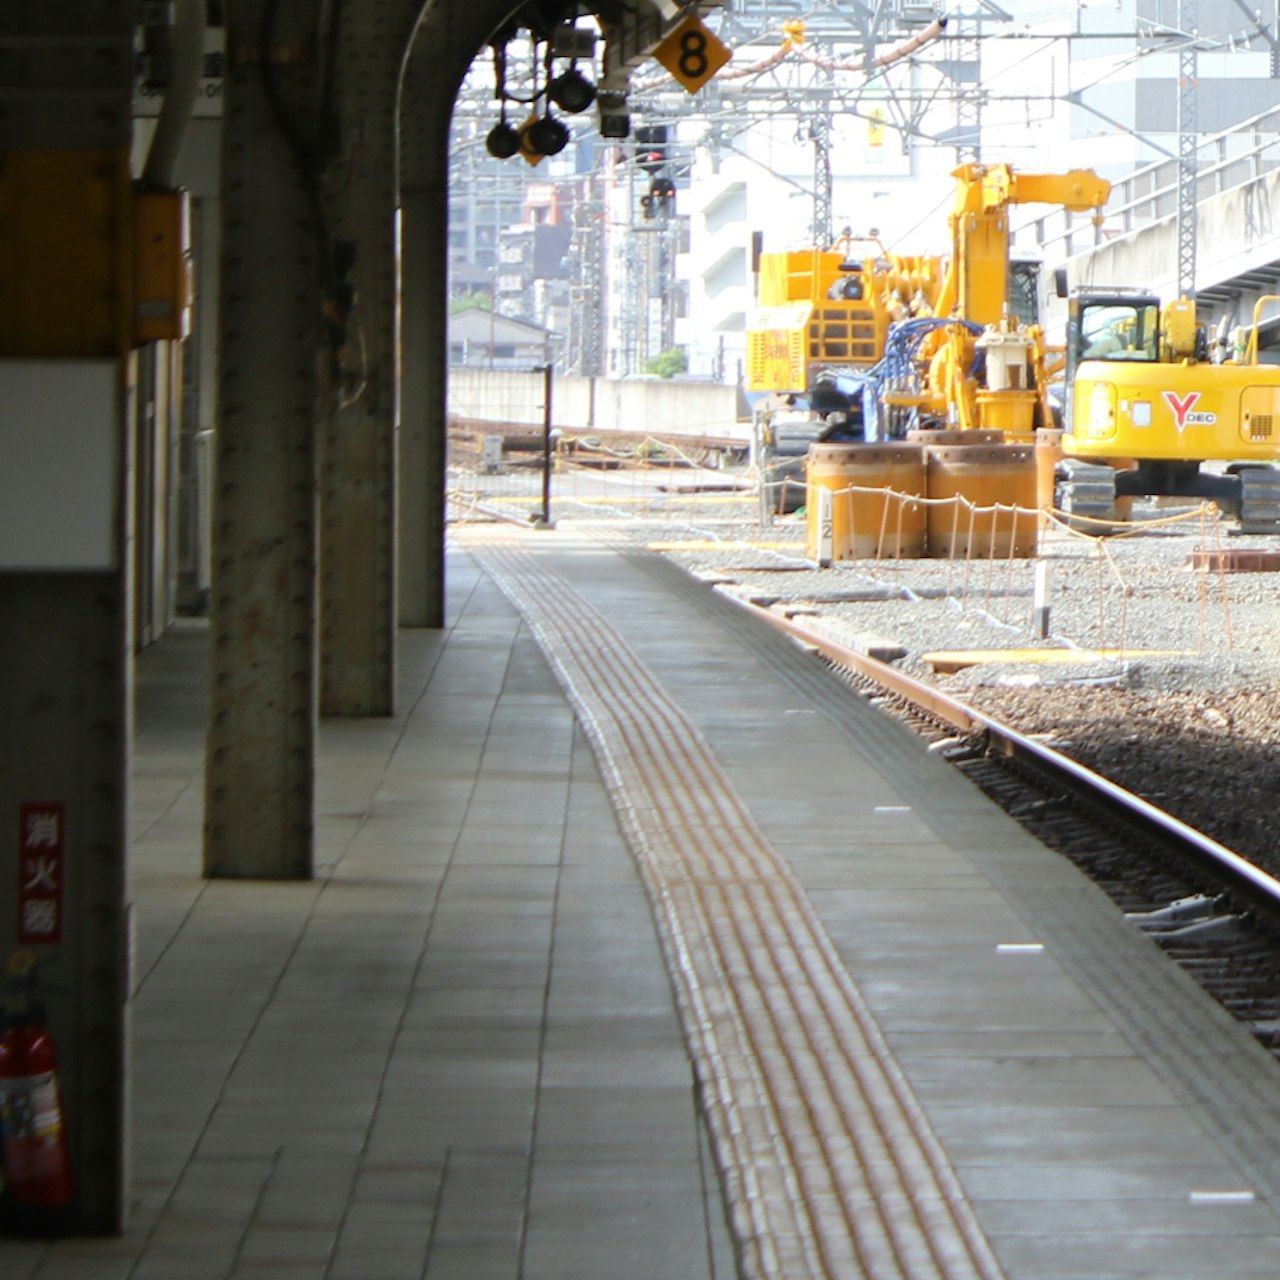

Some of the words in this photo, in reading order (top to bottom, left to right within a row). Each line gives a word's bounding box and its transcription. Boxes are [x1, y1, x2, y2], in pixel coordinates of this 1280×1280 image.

[678, 30, 709, 78] 8
[24, 812, 58, 934] 消火器
